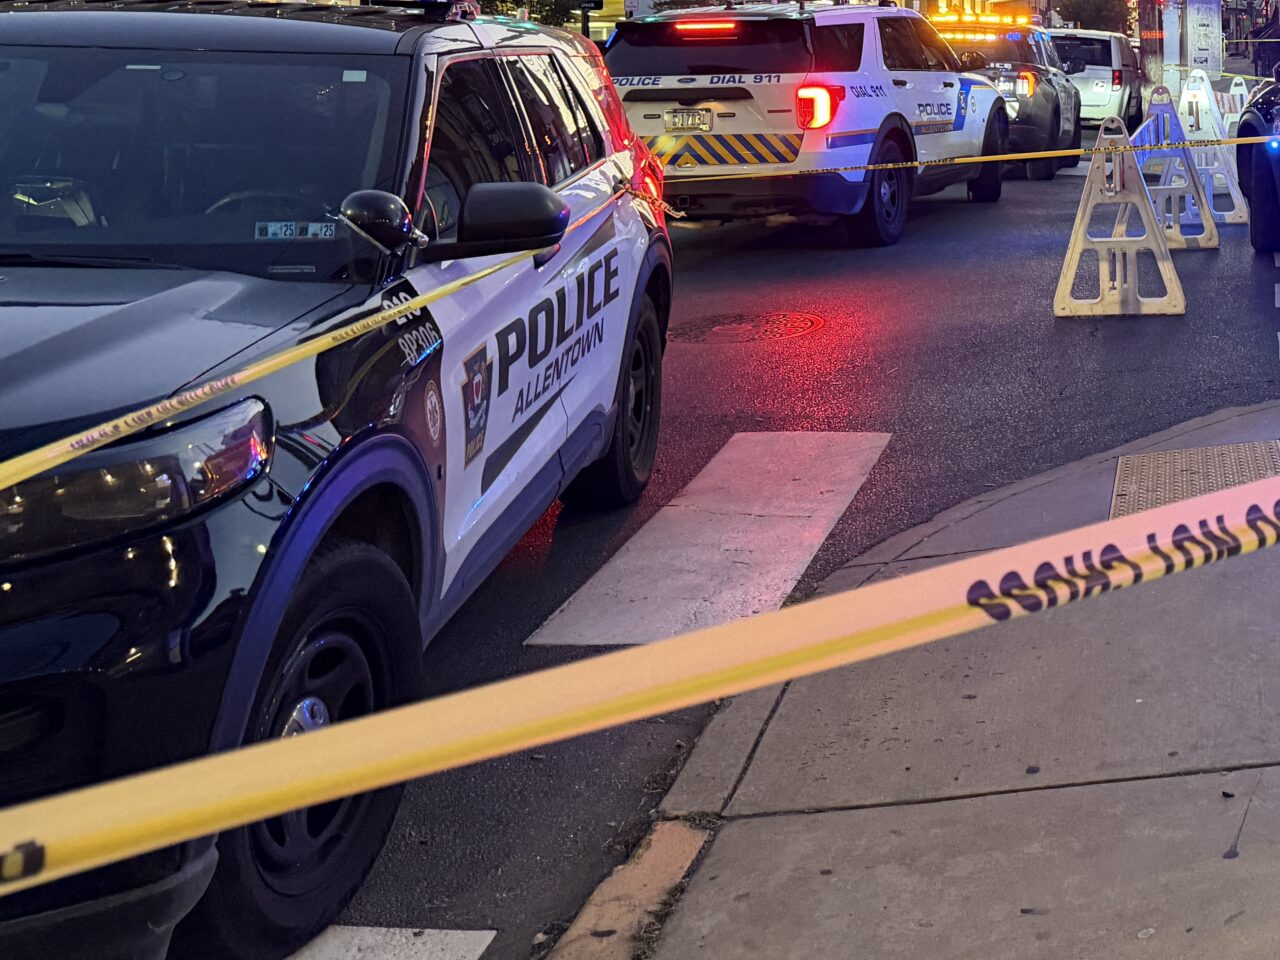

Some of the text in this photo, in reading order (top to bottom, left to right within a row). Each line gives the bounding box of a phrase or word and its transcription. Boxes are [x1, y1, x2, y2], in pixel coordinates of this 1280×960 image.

[709, 75, 746, 85] DIAL
[752, 74, 782, 84] 911
[849, 85, 888, 98] DIAL 911
[917, 102, 952, 116] POLICE
[495, 247, 620, 398] POLICE
[512, 317, 605, 423] ALLENTOWN
